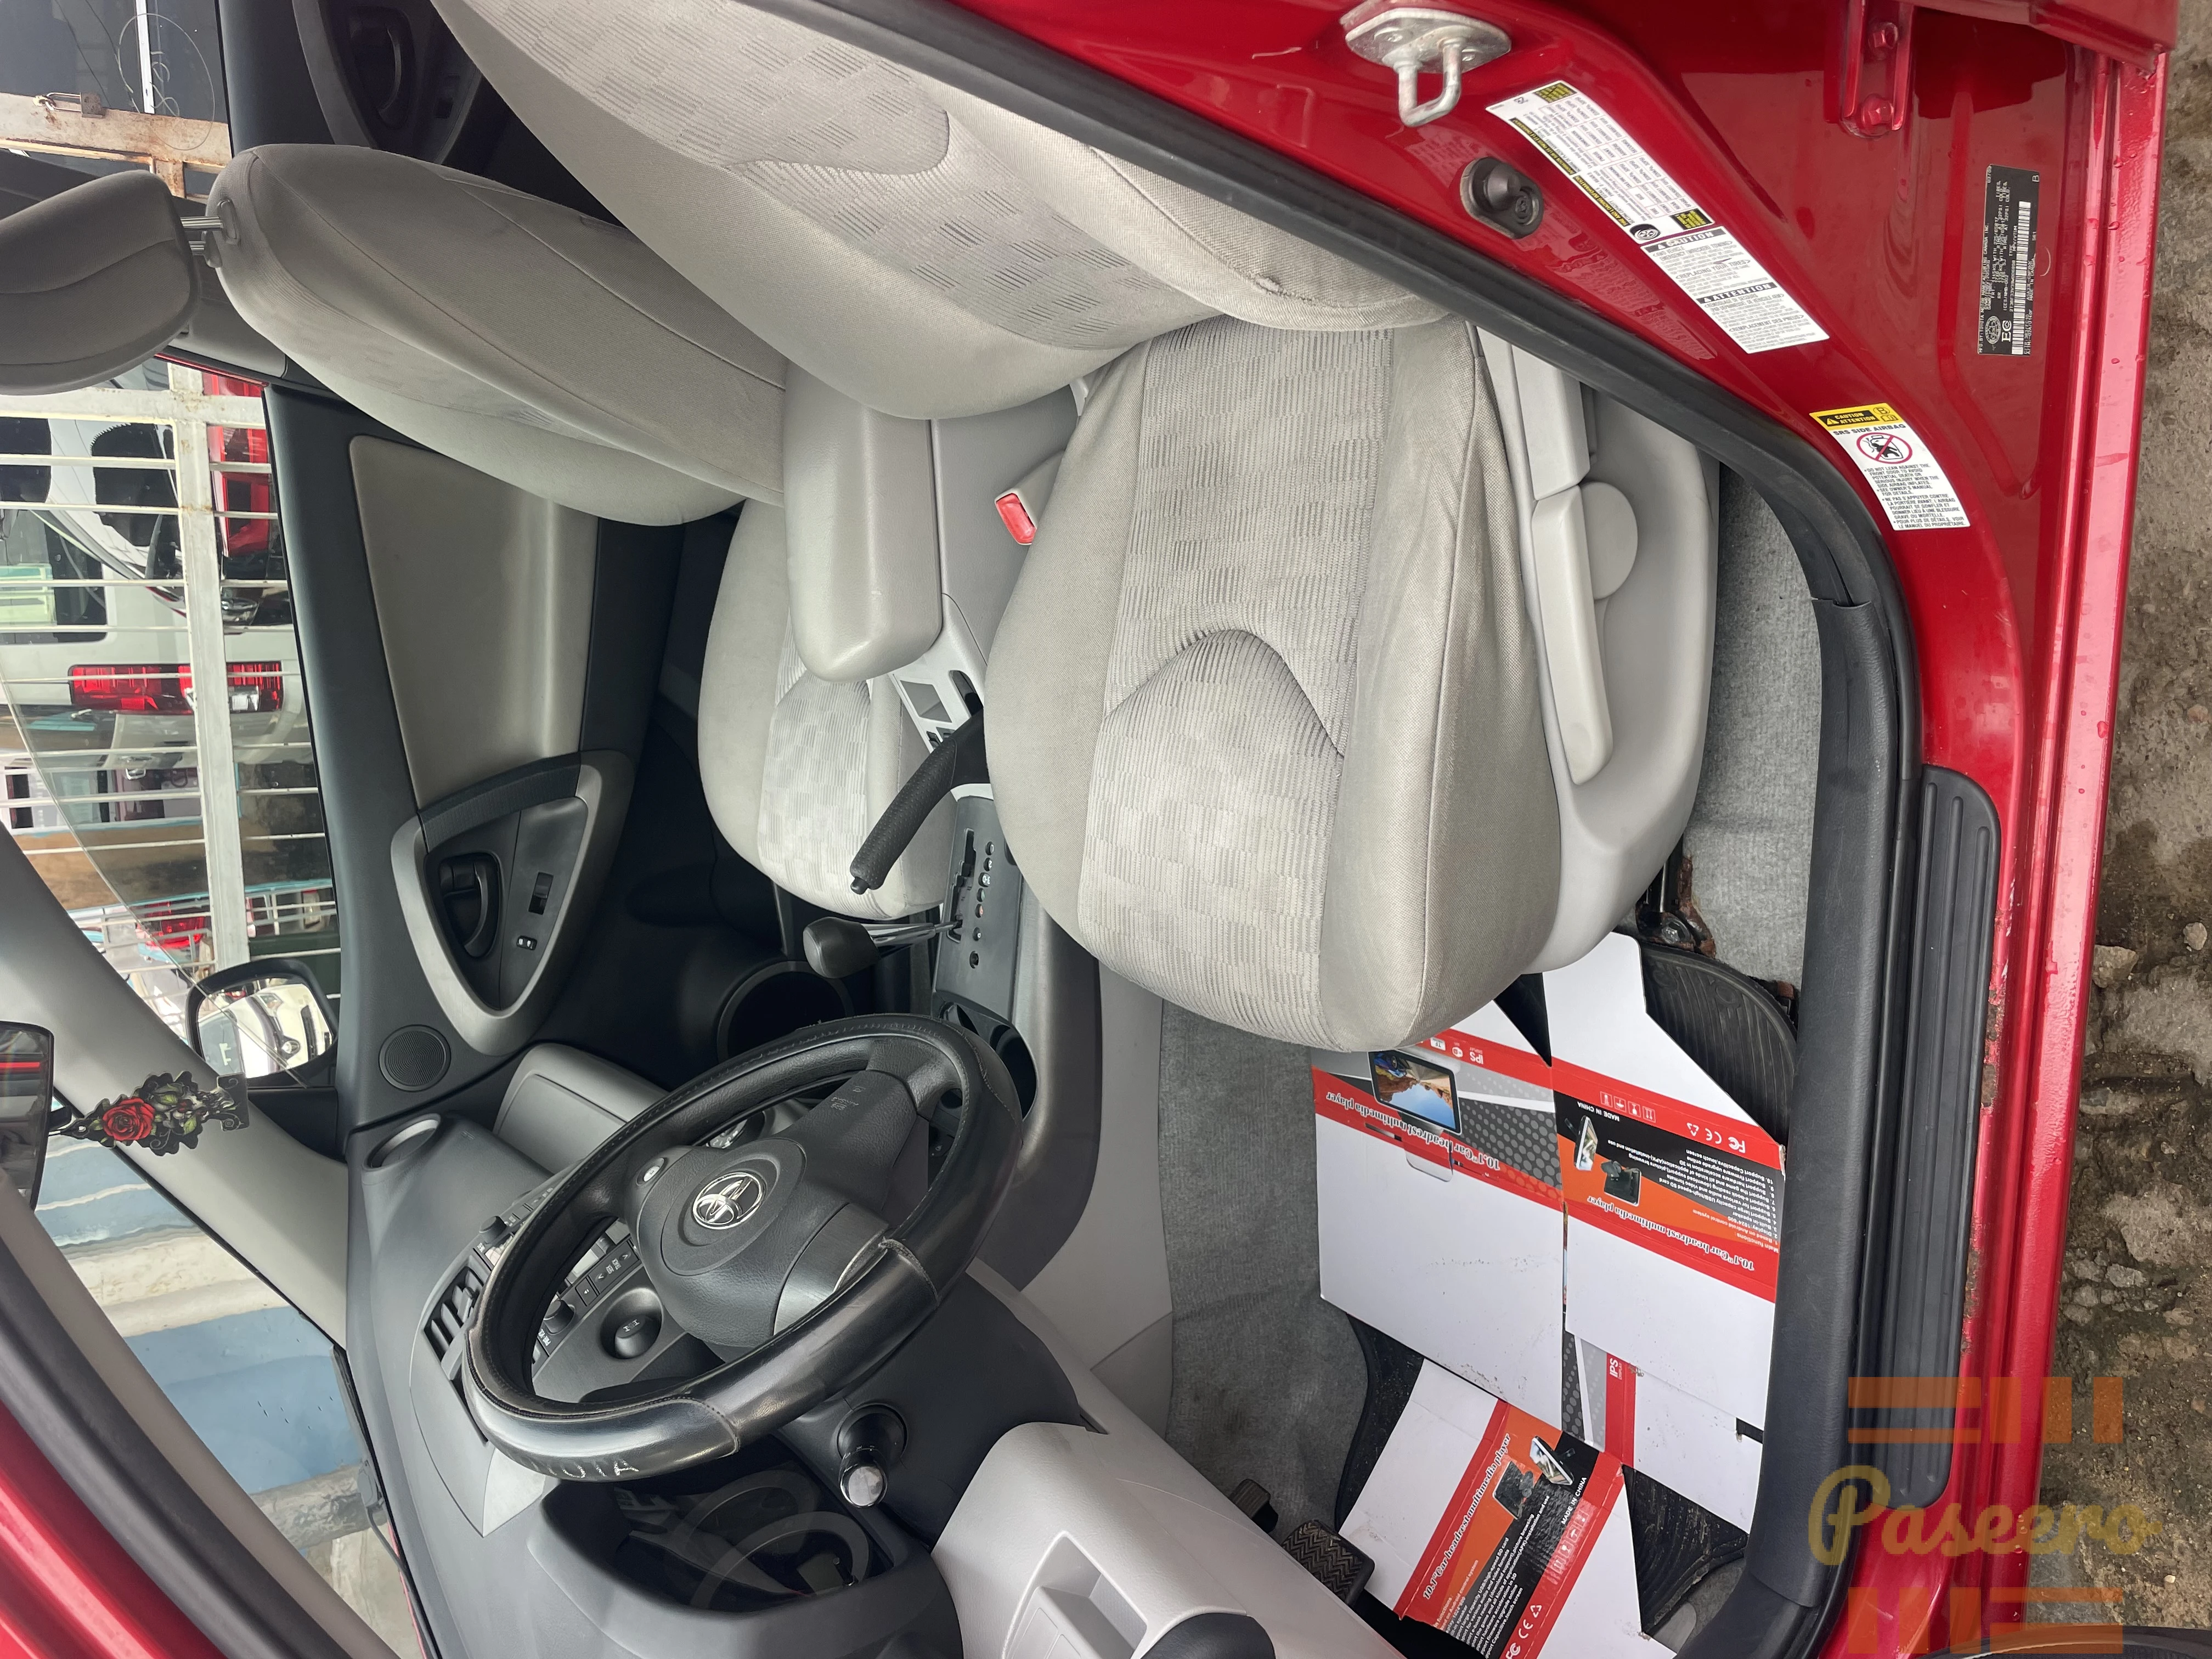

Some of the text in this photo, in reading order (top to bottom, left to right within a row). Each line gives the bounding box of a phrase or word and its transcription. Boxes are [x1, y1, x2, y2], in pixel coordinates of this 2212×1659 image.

[2032, 174, 2039, 182] B
[1664, 231, 1715, 247] CAUTION
[1710, 283, 1772, 301] ATTENTION
[1833, 411, 1865, 420] CAUTION
[1838, 415, 1876, 424] ATTENTION
[1872, 423, 1906, 431] AIRBAG
[1469, 1051, 1484, 1065] IPS
[1326, 1088, 1354, 1113] player
[1576, 1100, 1620, 1122] MADE IN CHINA
[1407, 1122, 1452, 1153] headrest
[1607, 1138, 1616, 1146] use
[1616, 1141, 1625, 1150] and
[1628, 1152, 1649, 1165] browsing
[1685, 1148, 1702, 1159] screen
[1686, 1155, 1701, 1165] online
[1691, 1163, 1721, 1179] acceleration
[1702, 1160, 1722, 1172] upgrade
[1658, 1176, 1669, 1186] card
[1666, 1173, 1684, 1184] formats
[1686, 1173, 1712, 1188] (download
[1695, 1170, 1708, 1181] kinds
[1721, 1174, 1745, 1188] hardware
[1722, 1168, 1745, 1181] firmware
[1744, 1169, 1764, 1182] Support
[1684, 1180, 1698, 1189] video
[1698, 1184, 1708, 1193] and
[1712, 1183, 1731, 1195] reading
[1716, 1178, 1725, 1187] and
[1725, 1182, 1739, 1192] game
[1745, 1176, 1765, 1189] Support
[1745, 1182, 1765, 1195] Support
[1708, 1188, 1722, 1199] audio
[1731, 1190, 1749, 1202] e-book
[1740, 1187, 1748, 1195] the
[1748, 1190, 1769, 1203] Support
[1586, 1192, 1615, 1216] player
[1716, 1198, 1736, 1210] capacity
[1722, 1194, 1741, 1206] various
[1749, 1197, 1770, 1210] Support
[1692, 1207, 1709, 1219] system
[1732, 1210, 1752, 1223] speaker
[1737, 1206, 1750, 1215] large
[1750, 1204, 1770, 1217] Support
[1750, 1211, 1771, 1223] Support
[1613, 1203, 1666, 1237] multimedia
[1710, 1215, 1728, 1226] control
[1752, 1218, 1771, 1230] Built-in
[1728, 1221, 1748, 1234] Android
[1666, 1225, 1709, 1254] headrest
[1756, 1232, 1772, 1243] Based
[1764, 1243, 1778, 1253] Main
[1609, 1358, 1618, 1378] IPS
[1443, 1513, 1472, 1560] headrest
[1464, 1462, 1499, 1518] multimedia
[1491, 1432, 1514, 1466] player
[1560, 1475, 1588, 1525] MADE IN CHINA
[1448, 1592, 1462, 1613] Android
[1458, 1576, 1470, 1594] control
[1466, 1558, 1479, 1578] system
[1461, 1612, 1471, 1627] large
[1467, 1592, 1481, 1615] capacity
[1496, 1547, 1504, 1556] SD
[1500, 1536, 1509, 1549] card
[1511, 1587, 1523, 1605] screen
[1481, 1613, 1497, 1638] hardware
[1493, 1584, 1511, 1615] acceleration
[1510, 1572, 1517, 1581] 3D
[1486, 1583, 1519, 1641] firmware upgrade online
